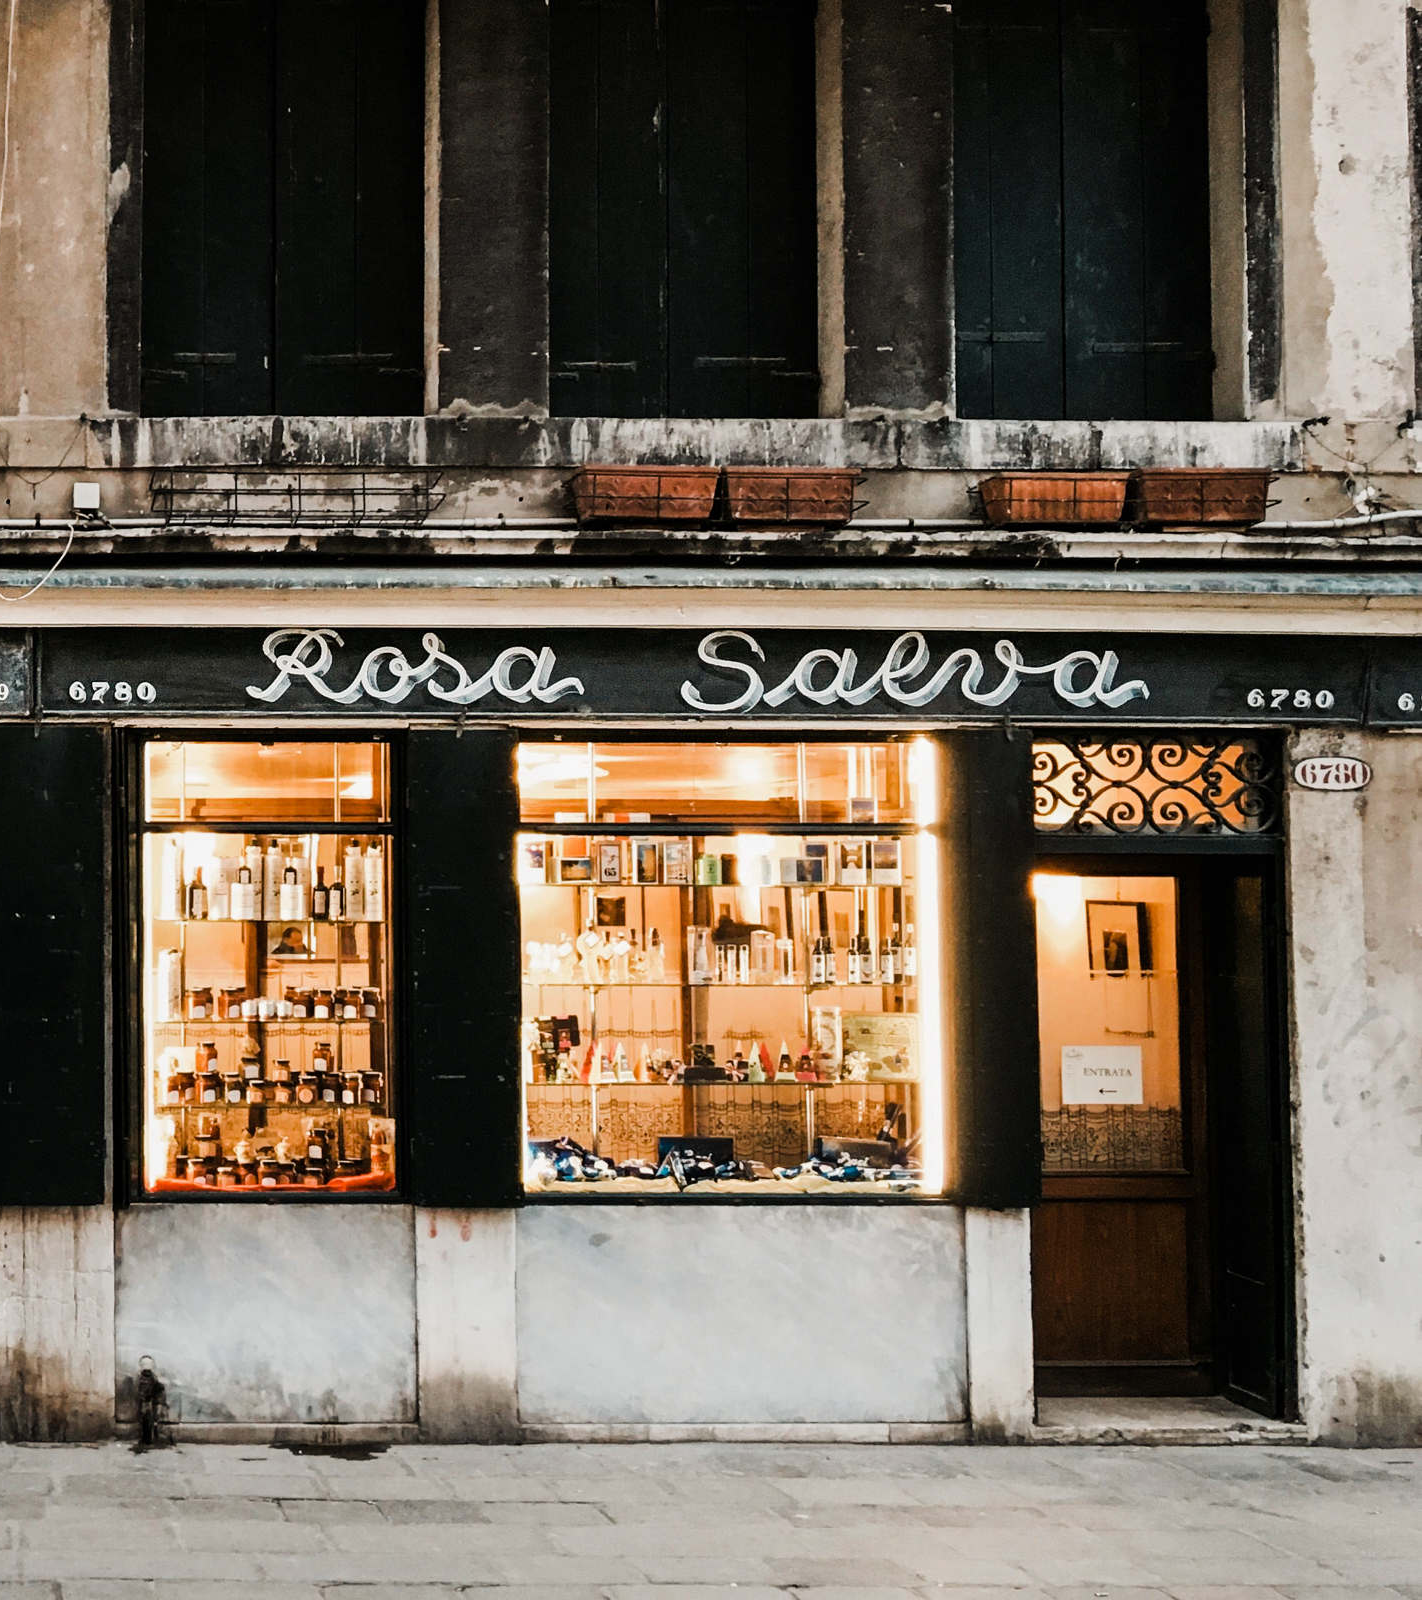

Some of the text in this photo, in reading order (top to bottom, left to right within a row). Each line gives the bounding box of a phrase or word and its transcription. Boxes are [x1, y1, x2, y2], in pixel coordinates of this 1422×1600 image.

[246, 627, 1149, 713] Rosa Salva
[68, 680, 156, 704] 6780
[1246, 688, 1335, 711] 6780
[1397, 692, 1422, 713] 6
[1300, 762, 1369, 785] 6780
[1083, 1067, 1132, 1077] ENTRATA
